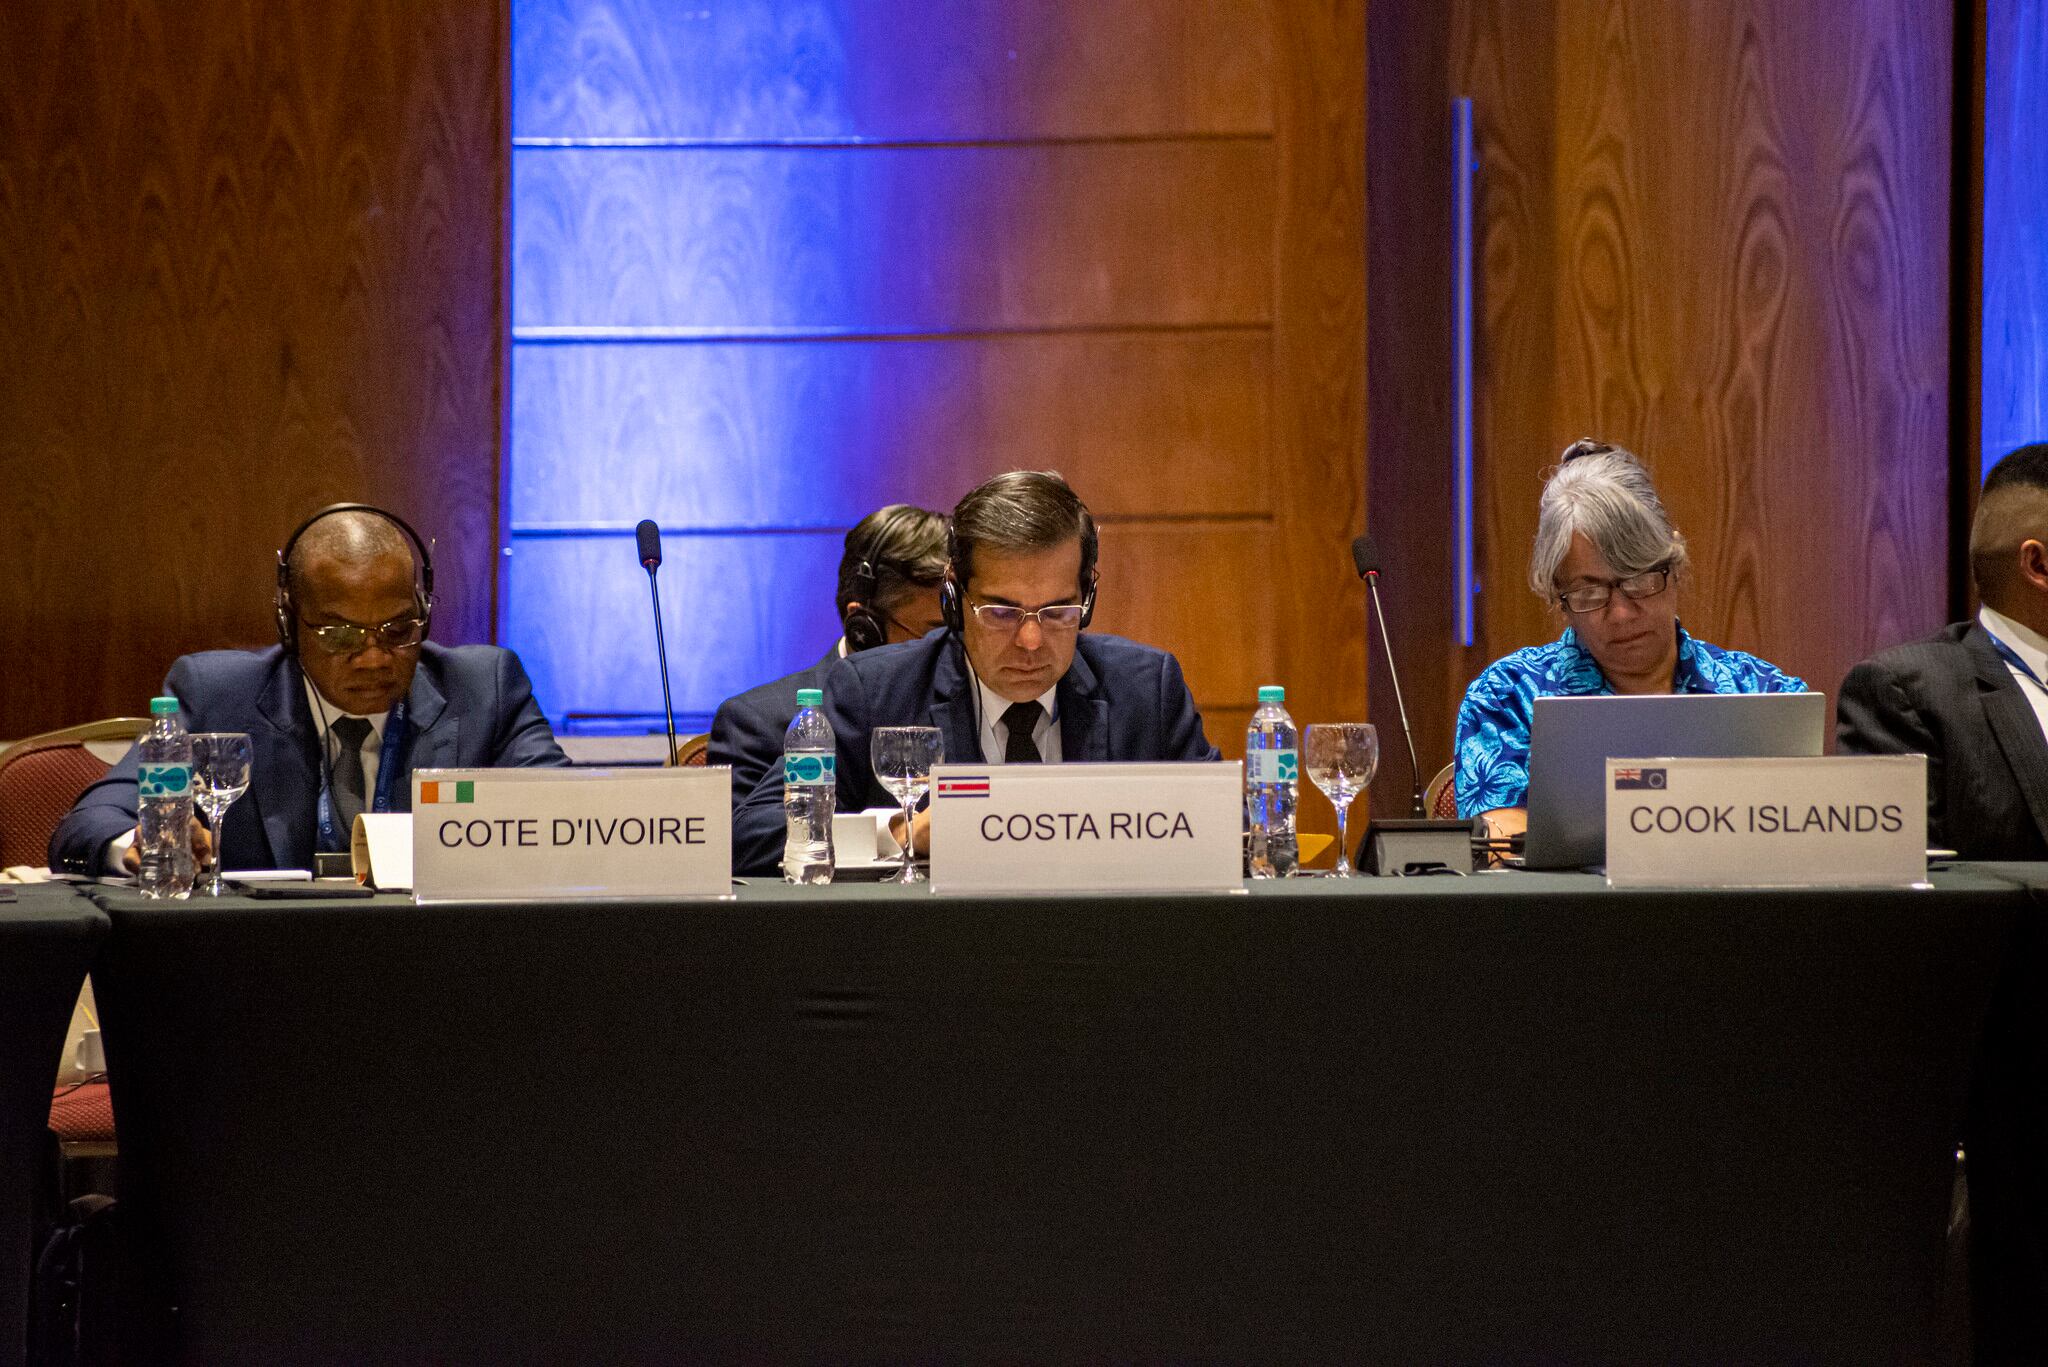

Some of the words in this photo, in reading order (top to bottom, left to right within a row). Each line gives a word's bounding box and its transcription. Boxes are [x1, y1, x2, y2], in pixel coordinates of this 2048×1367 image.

[438, 818, 540, 848] COTE
[552, 816, 706, 847] D'IVOIRE
[980, 812, 1101, 842] COSTA
[1110, 811, 1194, 841] RICA
[1630, 805, 1736, 834] COOK
[1748, 804, 1903, 834] ISLANDS
